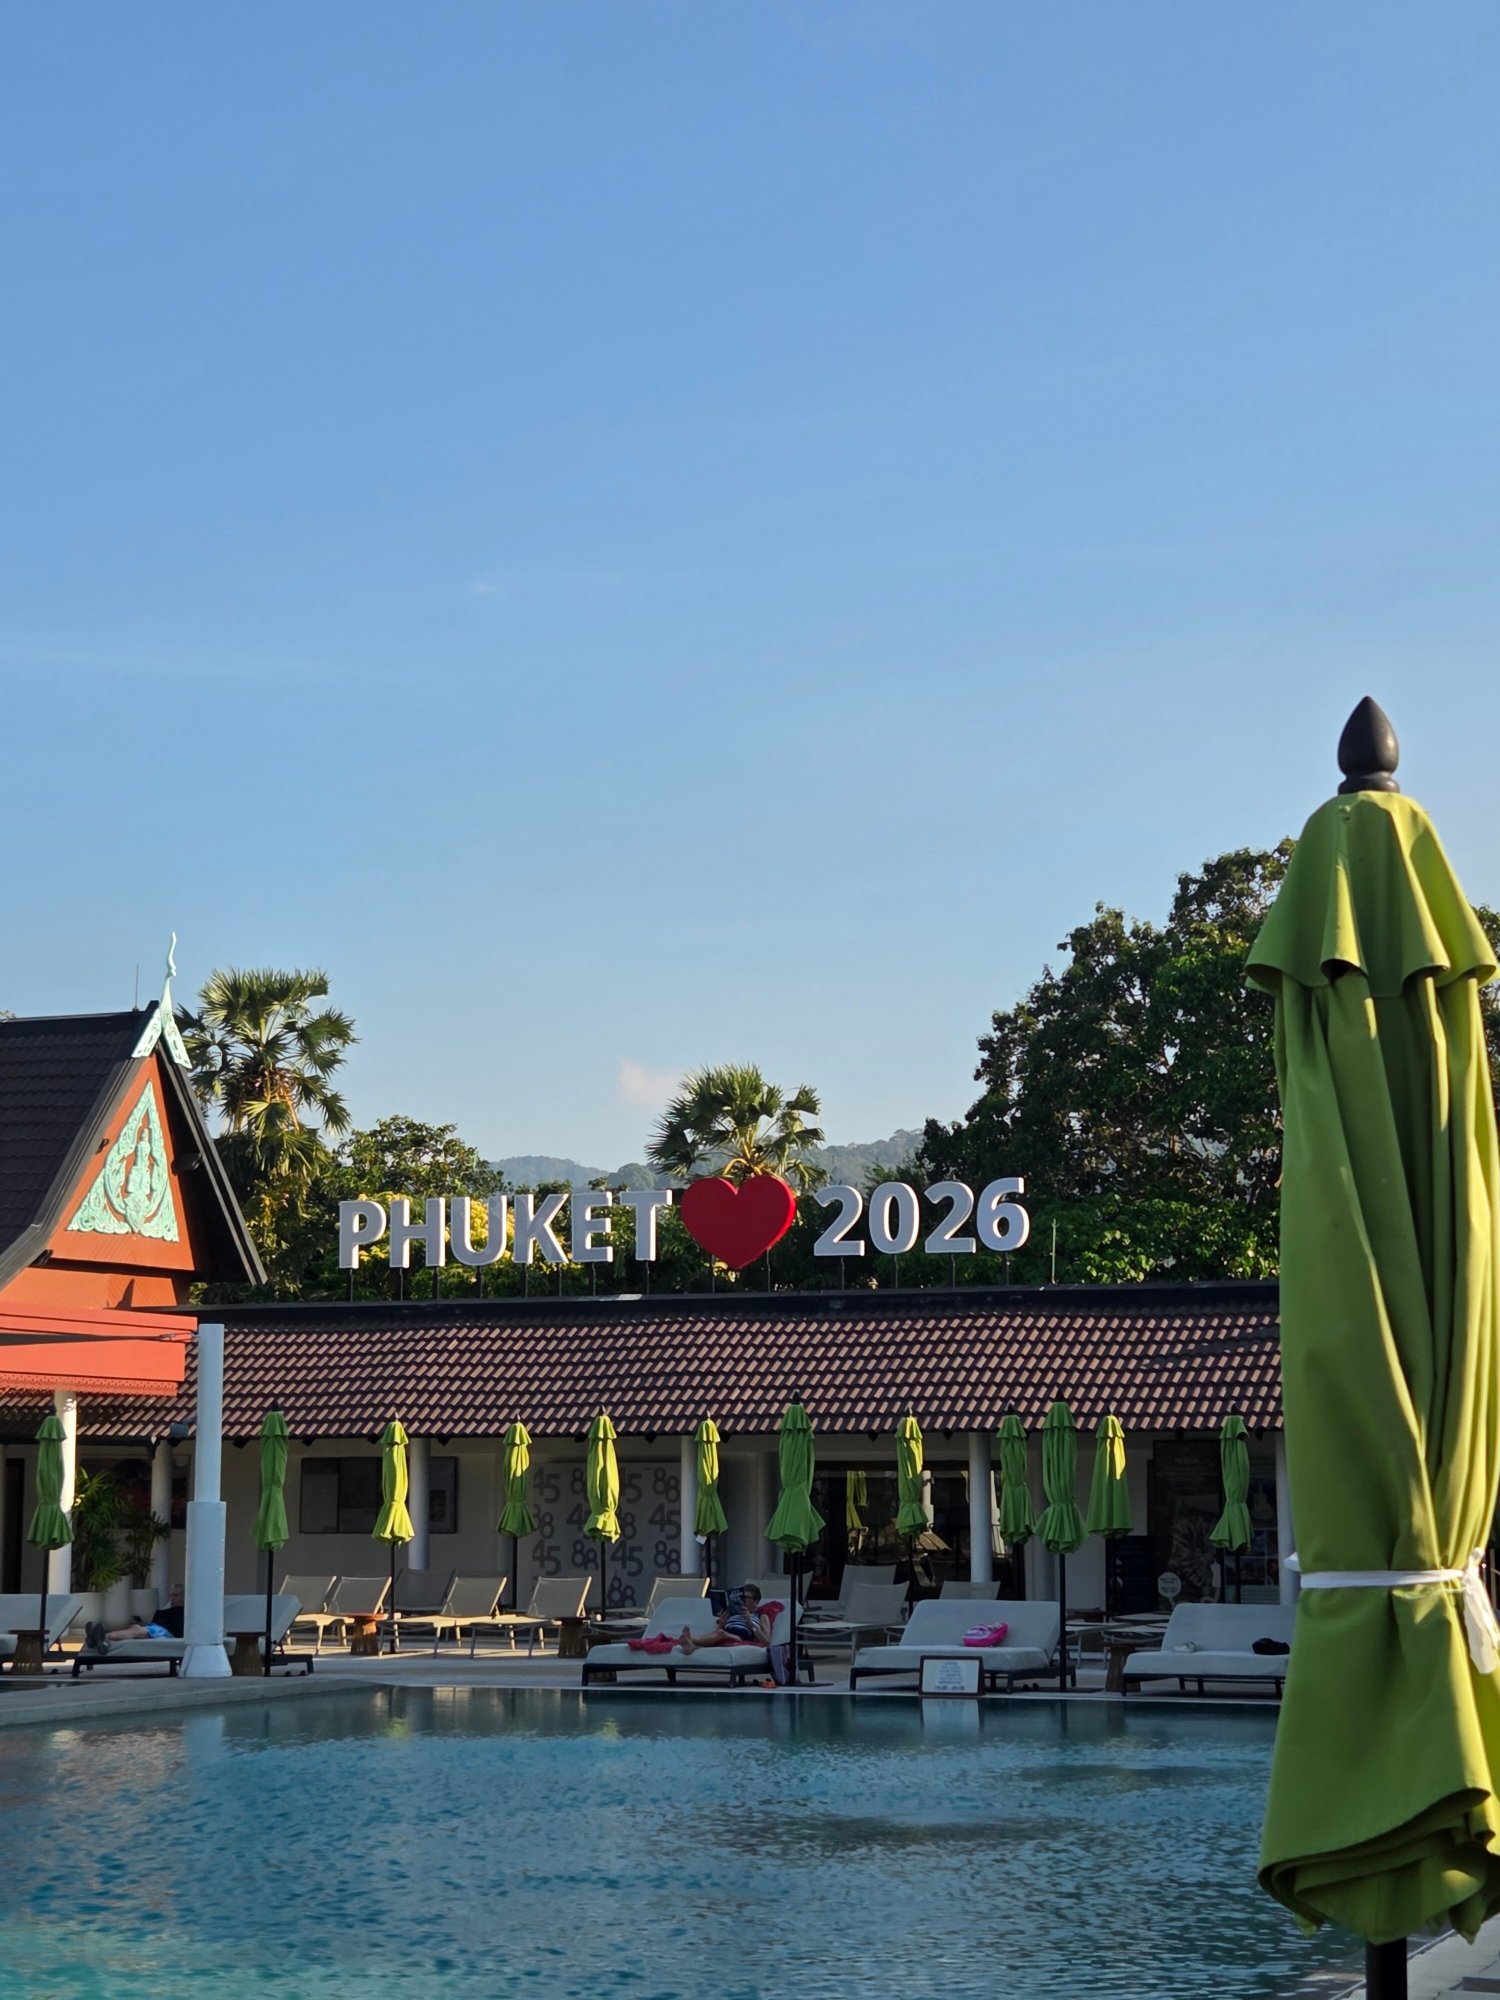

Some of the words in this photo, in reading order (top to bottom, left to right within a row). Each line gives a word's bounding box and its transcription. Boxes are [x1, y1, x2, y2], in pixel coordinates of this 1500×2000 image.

[338, 1190, 673, 1269] PHUKET
[813, 1177, 1030, 1257] 2026
[534, 1467, 560, 1504] 45
[653, 1467, 680, 1504] 88
[567, 1504, 590, 1539] 4
[649, 1504, 681, 1541] 45
[532, 1540, 561, 1577] 45
[610, 1541, 643, 1577] 45
[653, 1540, 681, 1575] 88
